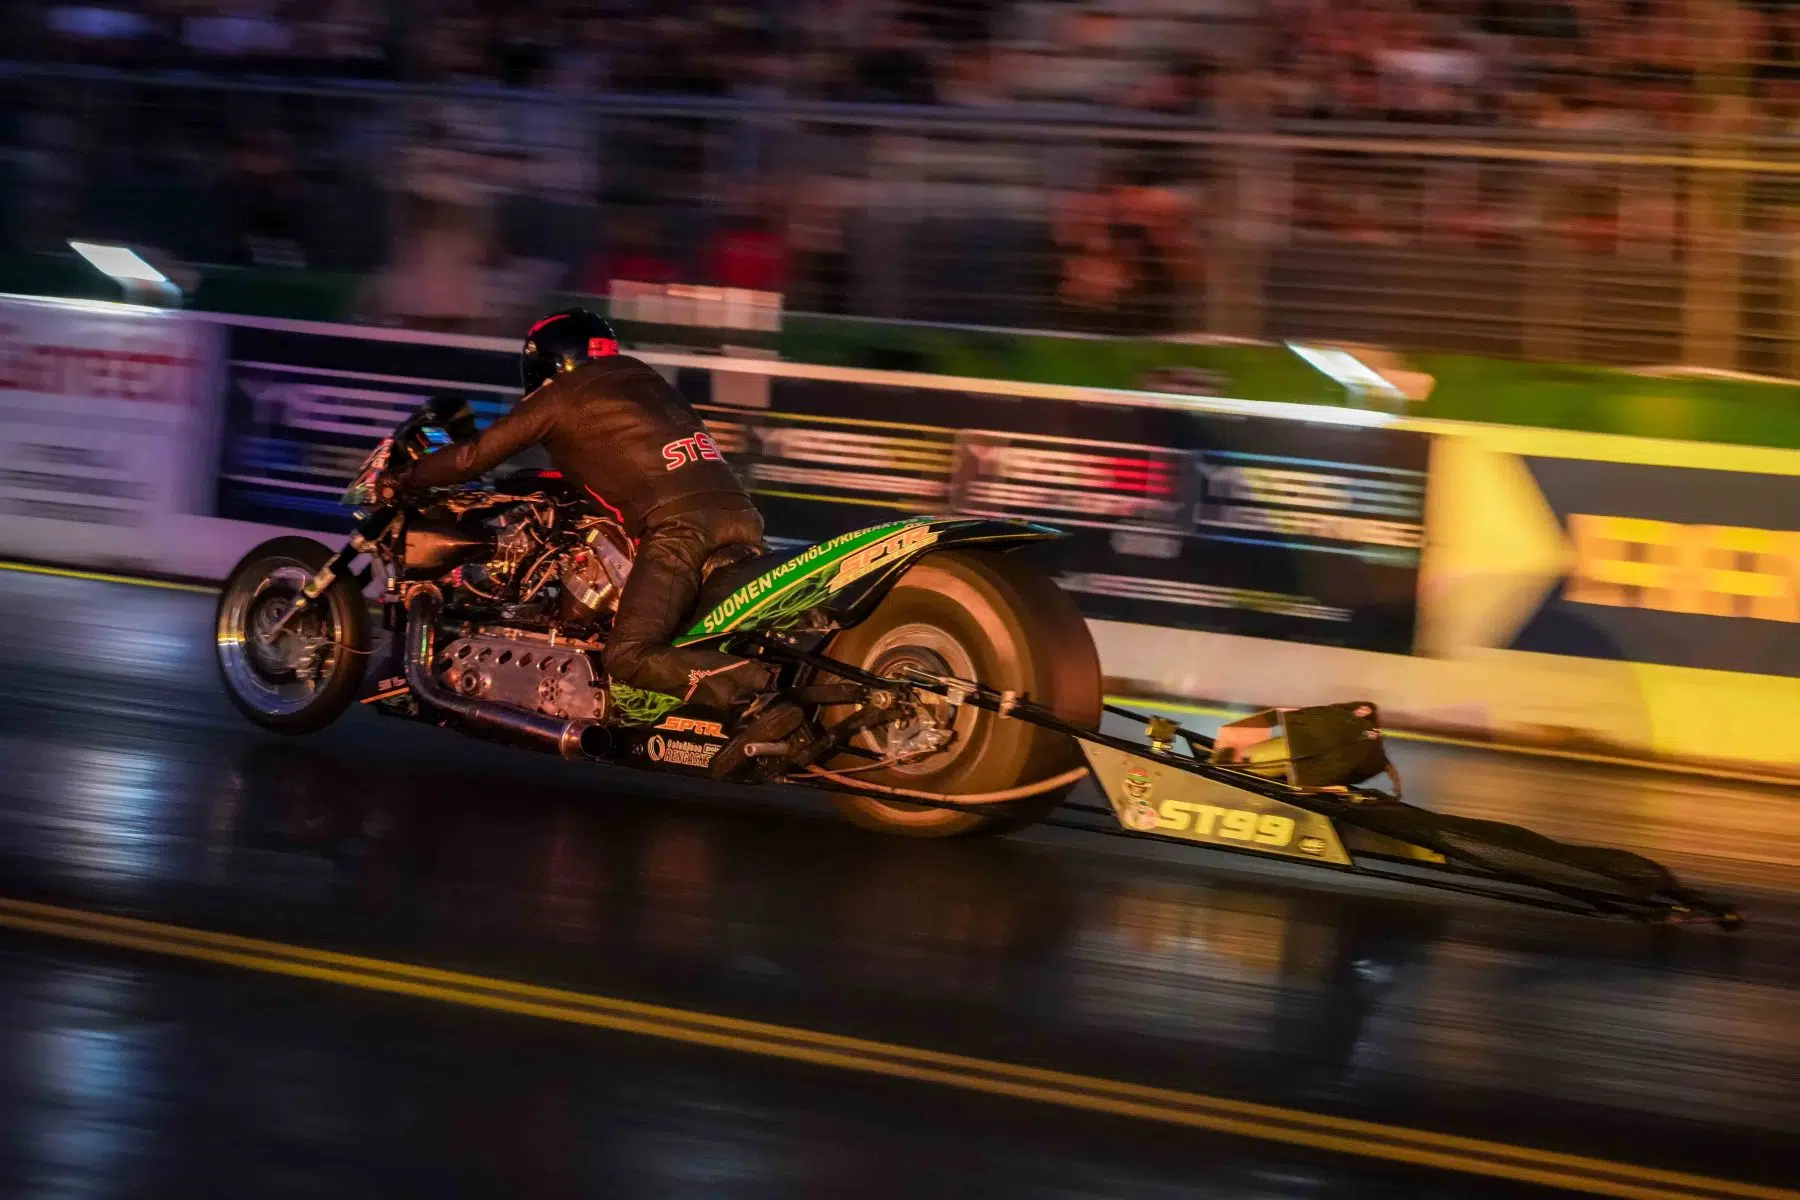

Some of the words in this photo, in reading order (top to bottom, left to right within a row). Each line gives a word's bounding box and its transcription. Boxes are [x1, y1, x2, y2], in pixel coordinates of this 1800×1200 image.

[827, 525, 937, 585] SPTR
[703, 573, 773, 634] SUOMEN
[654, 716, 730, 739] SPTR
[1156, 800, 1295, 847] ST99
